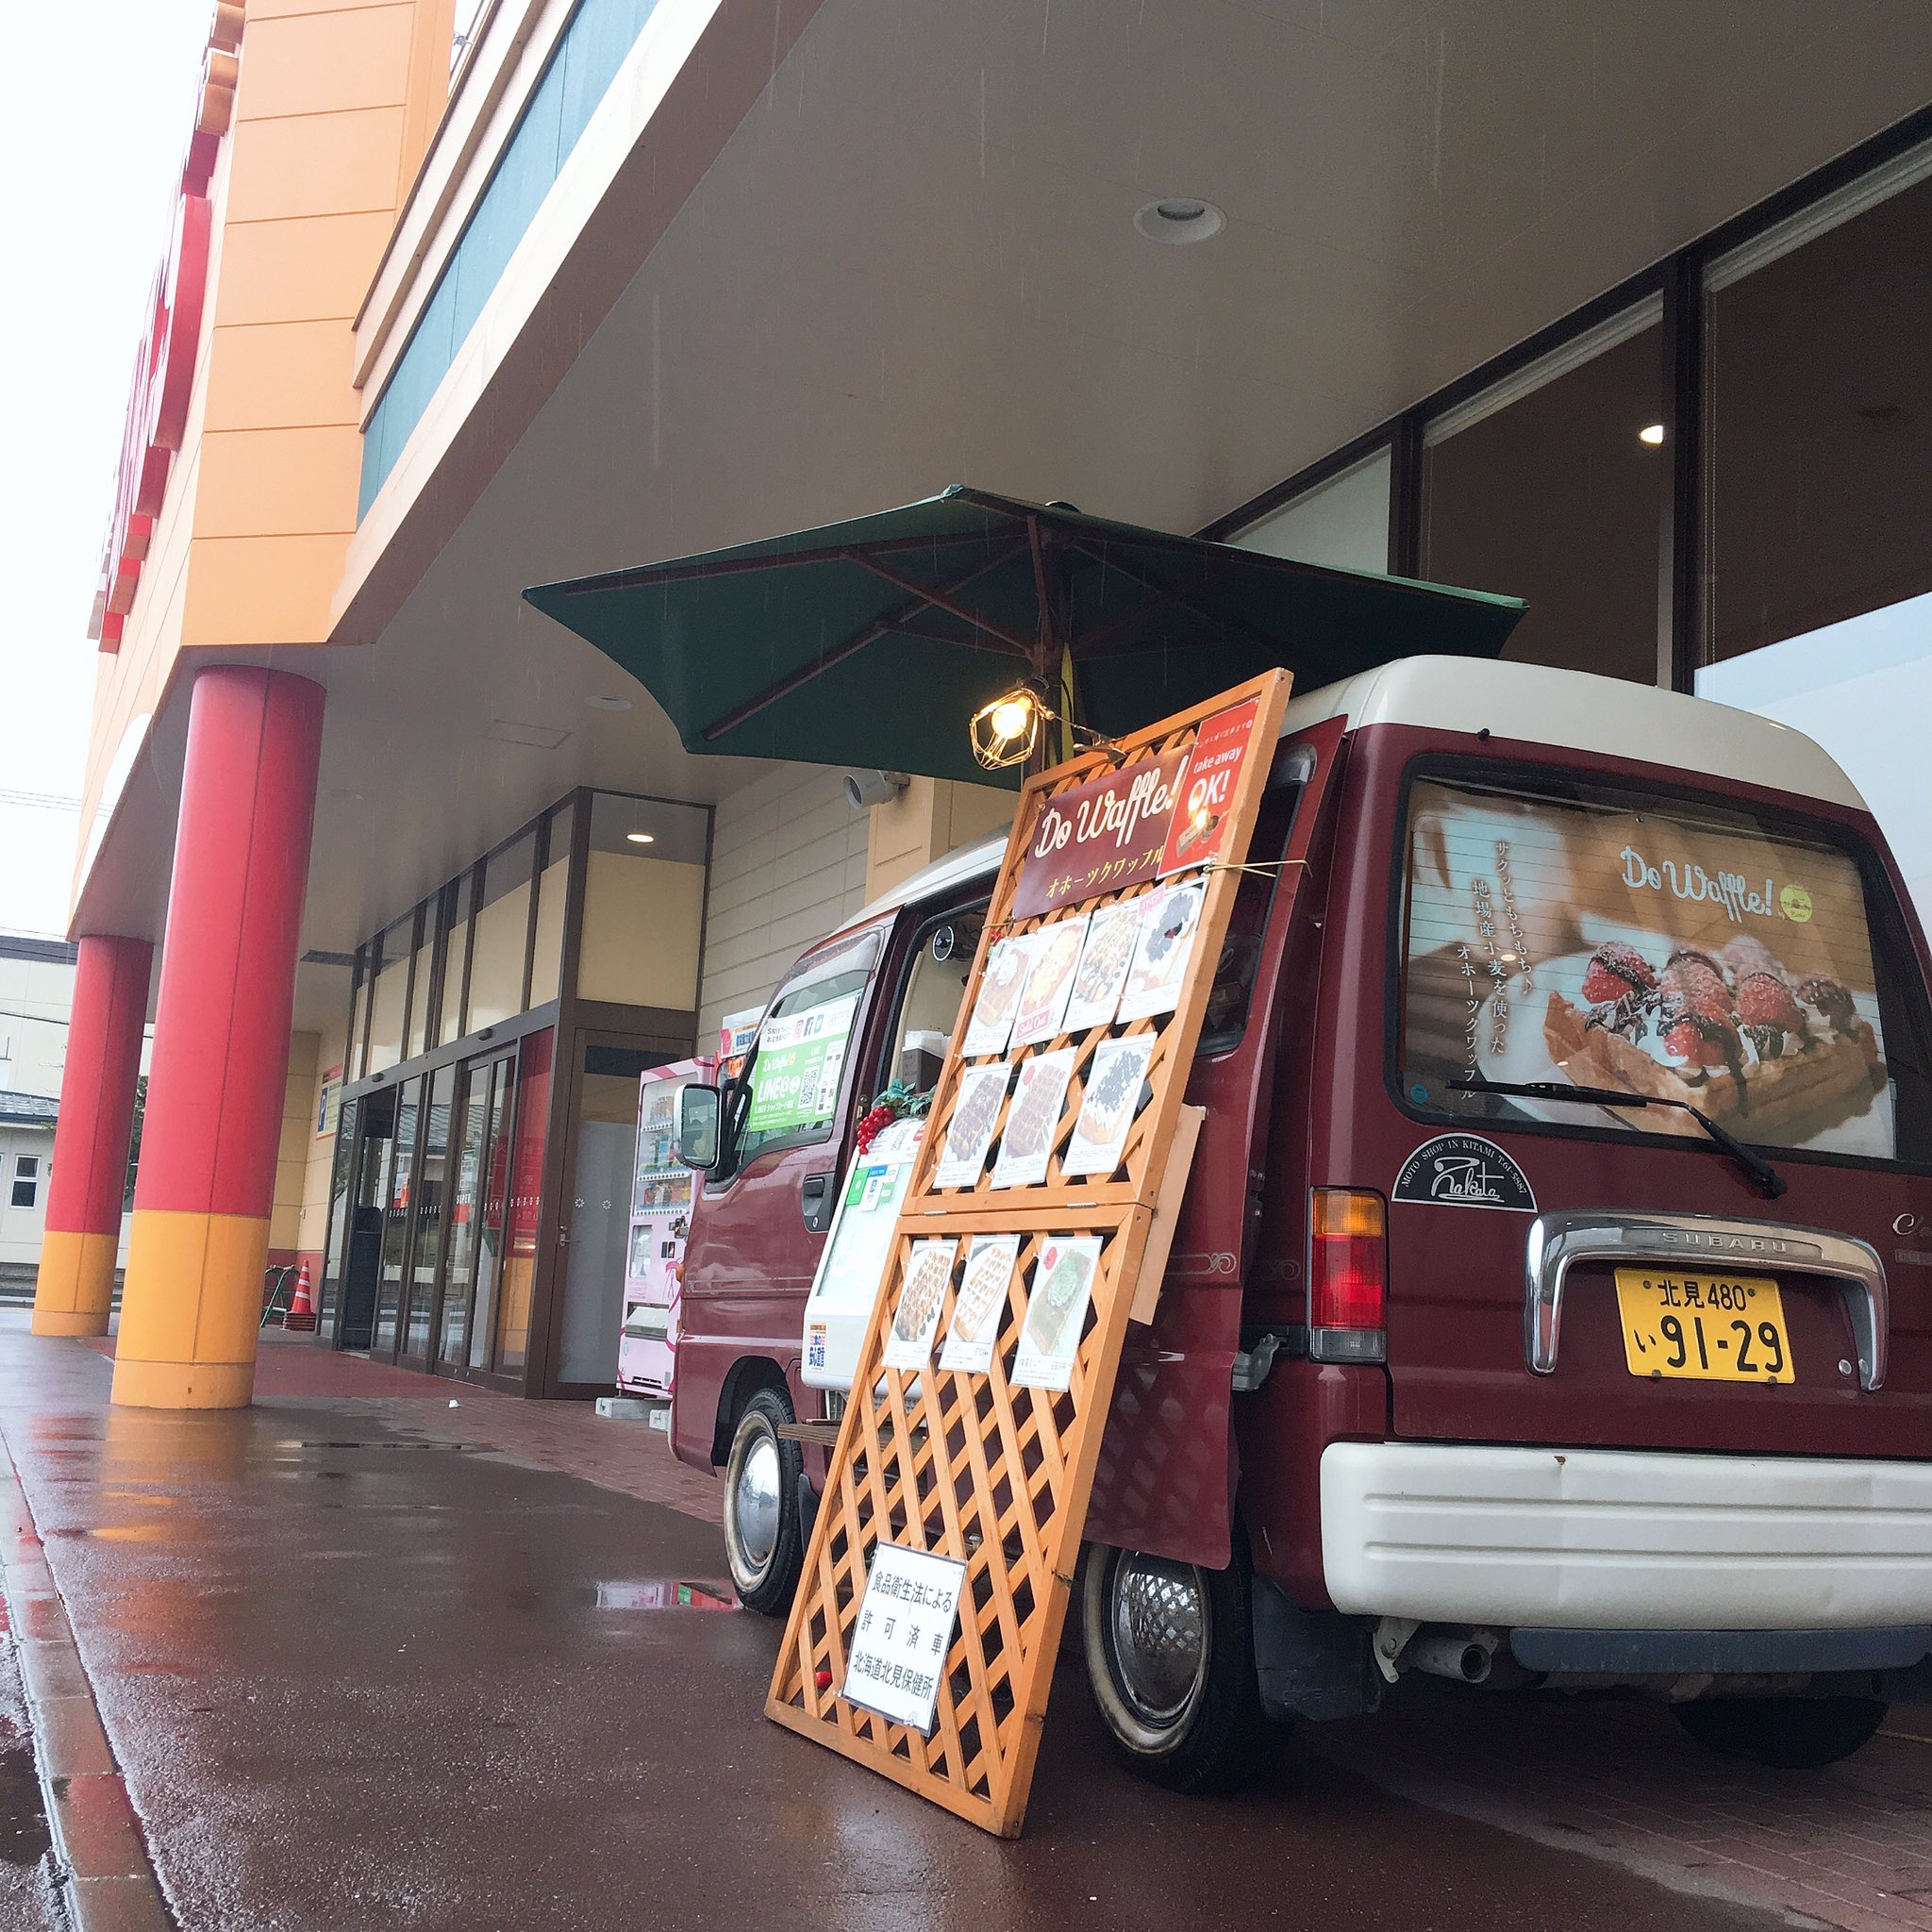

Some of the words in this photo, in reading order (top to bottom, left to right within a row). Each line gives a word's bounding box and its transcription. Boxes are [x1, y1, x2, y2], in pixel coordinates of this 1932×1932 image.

[1193, 755, 1214, 775] take
[1214, 745, 1243, 769] away
[1034, 808, 1073, 858] Do
[1076, 754, 1190, 848] Waffle!
[1188, 769, 1231, 812] OK!
[1046, 844, 1165, 899] オホーツクワッフル
[1620, 845, 1662, 891] Do
[1662, 860, 1774, 924] Waffle!
[1472, 880, 1508, 1055] 地場産小麦を使った
[1401, 1160, 1421, 1188] MOTO
[1421, 1143, 1444, 1160] SHOP
[1447, 1140, 1458, 1149] IN
[1462, 1140, 1495, 1158] KITAMI
[1497, 1156, 1527, 1194] T.61-5887
[1662, 1231, 1787, 1253] SUBARU
[1657, 1279, 1705, 1309] 北見
[1707, 1283, 1747, 1312] 480
[1634, 1330, 1657, 1354] い
[1660, 1315, 1784, 1374] 91-29
[872, 1571, 953, 1613] 食品衛生法による
[853, 1650, 935, 1702] 北海道北見保健所
